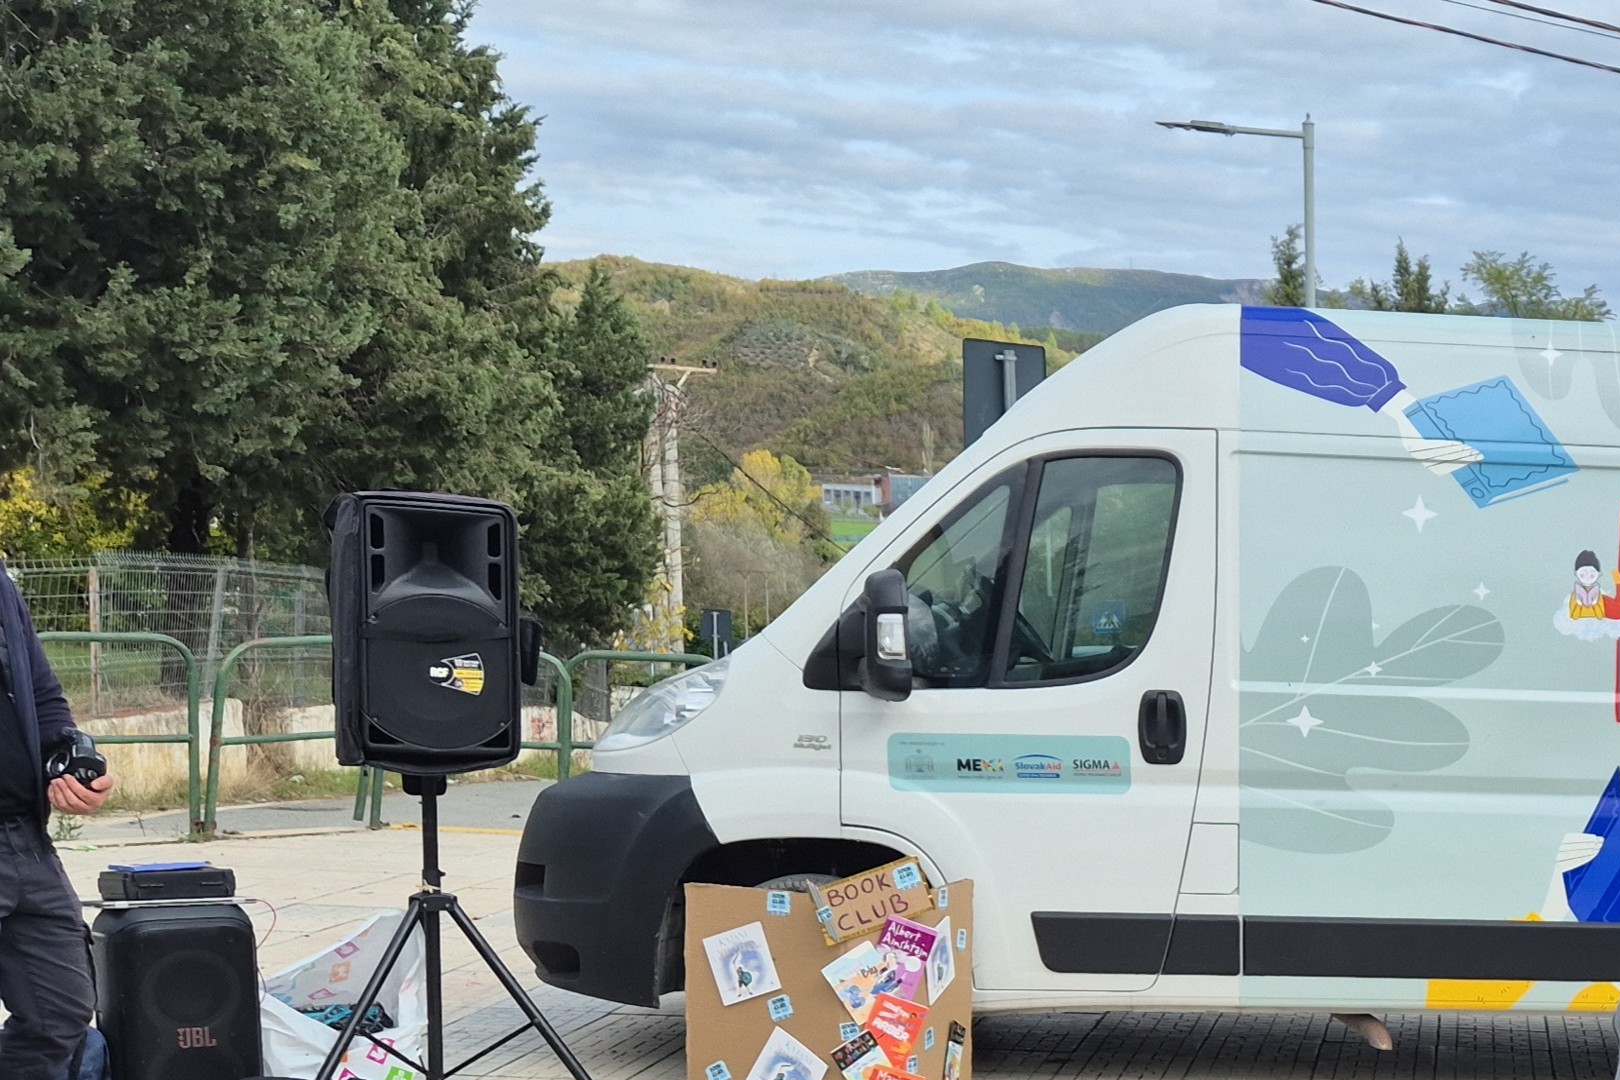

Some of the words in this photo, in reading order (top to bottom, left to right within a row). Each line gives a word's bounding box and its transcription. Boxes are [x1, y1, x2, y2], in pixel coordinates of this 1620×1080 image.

[1073, 759, 1110, 770] SIGMA
[827, 873, 891, 907] BOOK
[838, 894, 909, 931] CLUB
[888, 921, 922, 941] Albert
[177, 1026, 217, 1048] JBL
